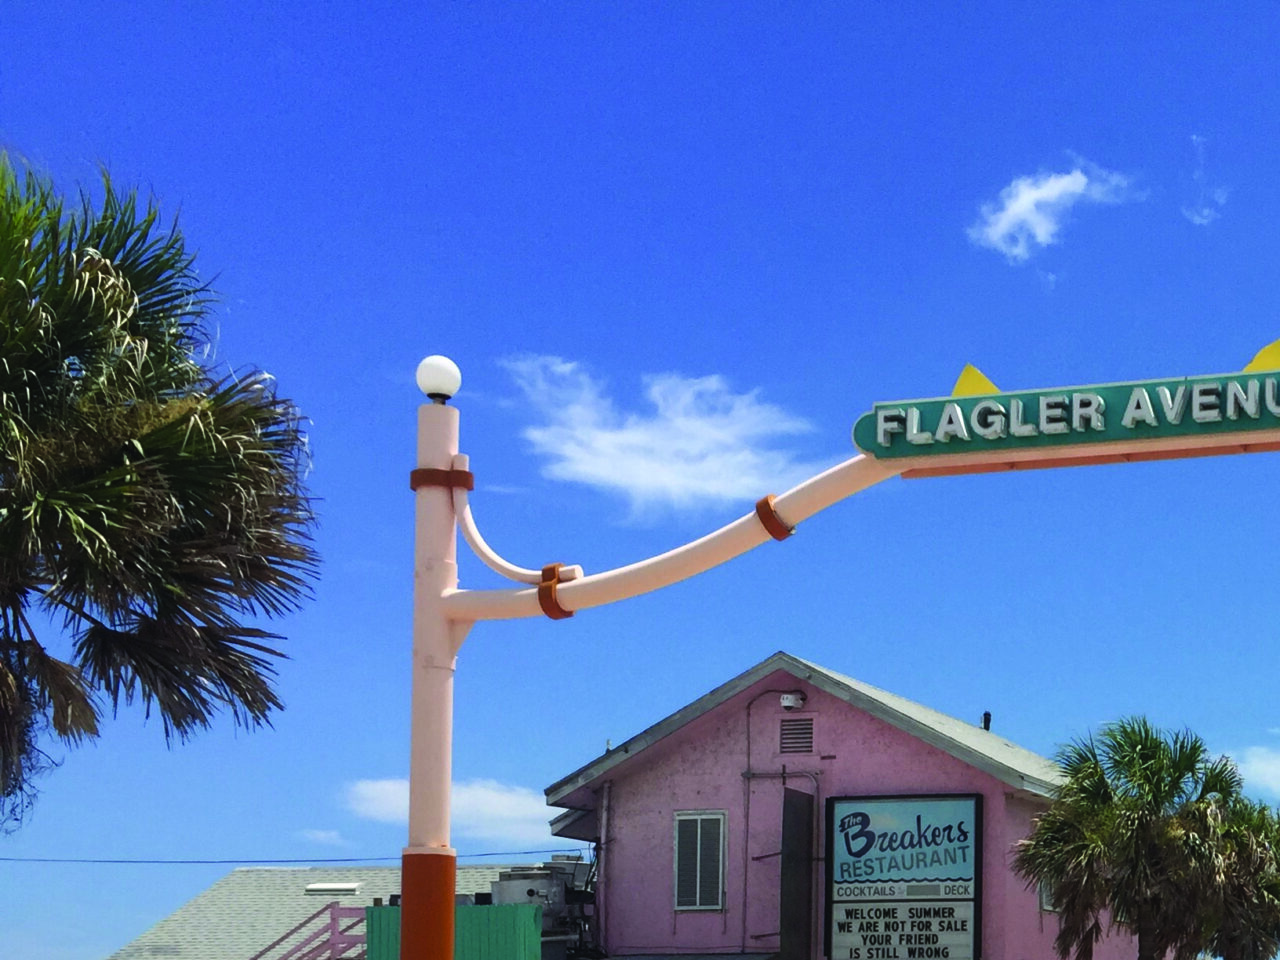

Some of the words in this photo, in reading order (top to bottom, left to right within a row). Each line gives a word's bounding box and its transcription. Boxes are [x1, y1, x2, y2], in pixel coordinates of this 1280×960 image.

[876, 391, 1106, 447] FLAGLER
[843, 815, 862, 829] The
[839, 812, 970, 858] Breakers
[840, 845, 970, 879] RESTAURANT
[837, 885, 896, 897] COCKTAILS
[944, 884, 970, 896] DECK
[844, 908, 898, 920] WELCOME
[908, 907, 955, 919] SUMMER
[837, 921, 853, 933] WE
[858, 921, 879, 933] ARE
[884, 921, 906, 932] NOT
[911, 920, 932, 932] FOR
[938, 920, 968, 932] SALE
[861, 934, 892, 946] YOUR
[899, 933, 939, 945] FRIEND
[850, 948, 861, 959] IS
[867, 947, 900, 959] STILL
[908, 947, 949, 959] WRONG
